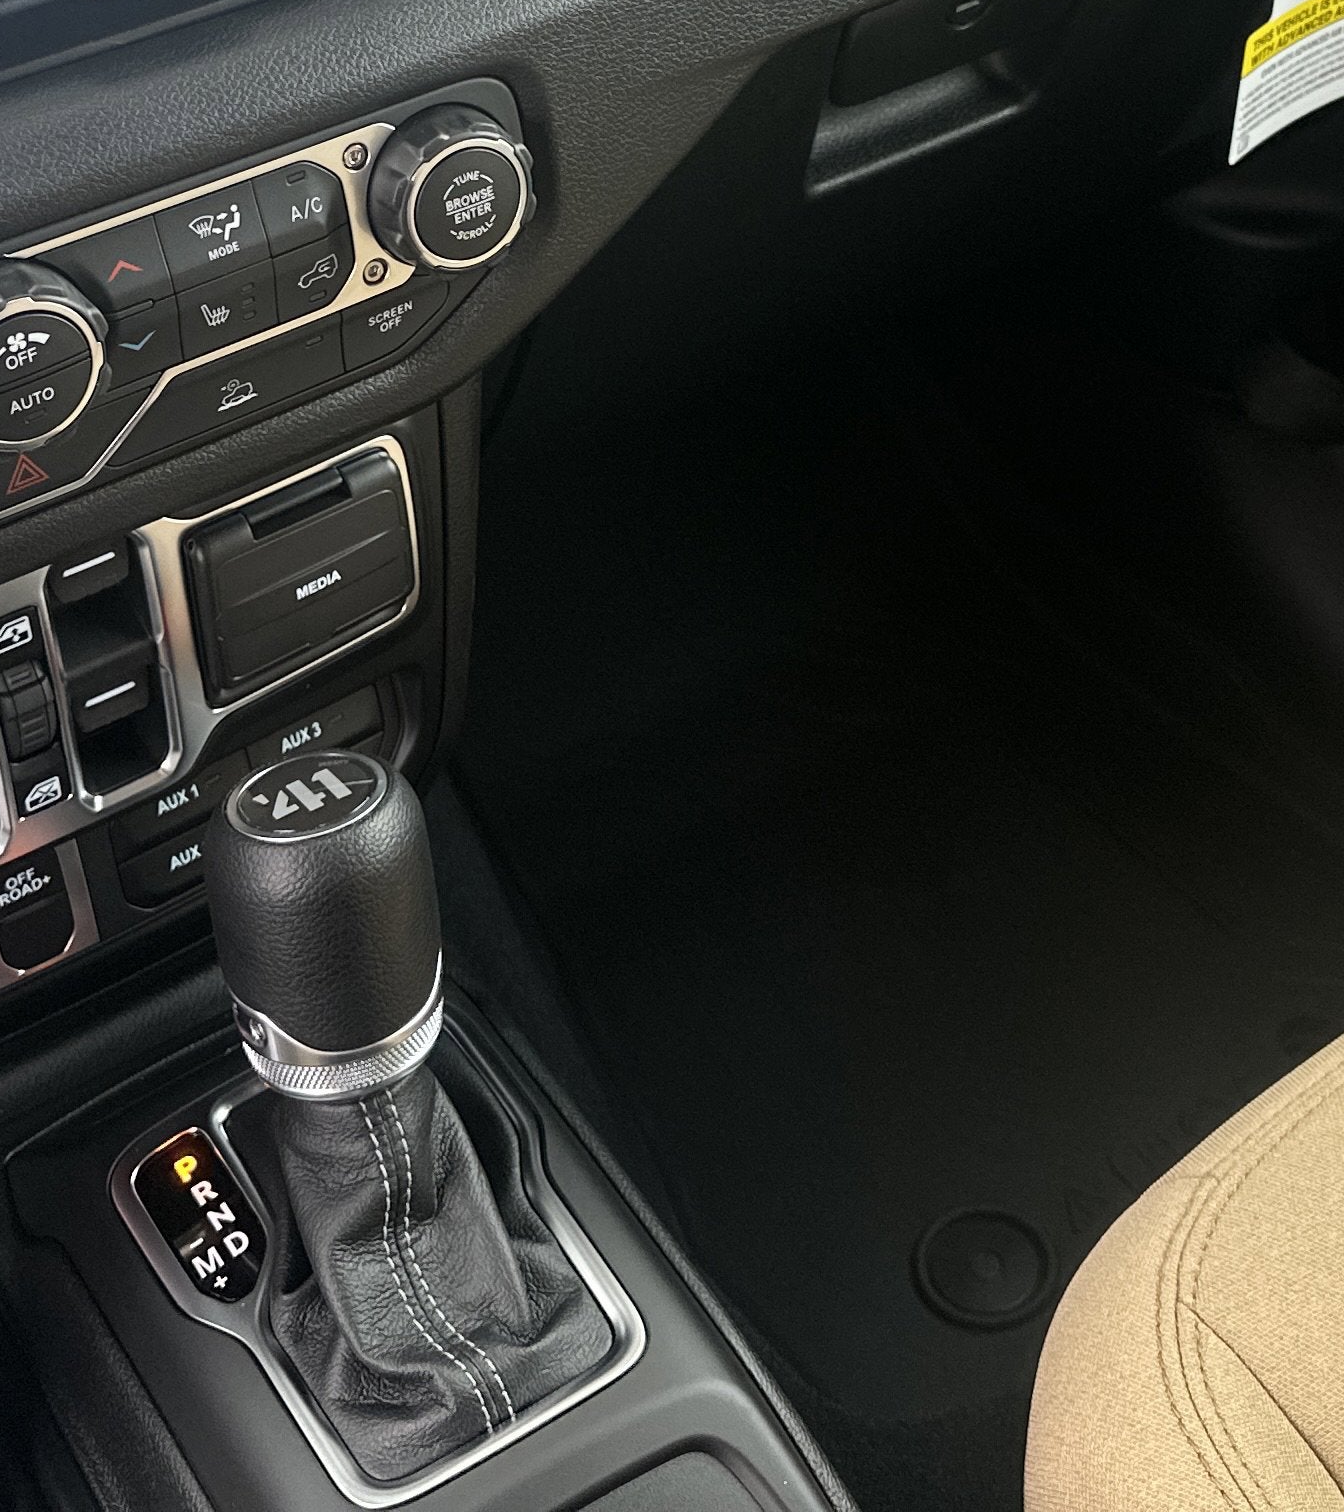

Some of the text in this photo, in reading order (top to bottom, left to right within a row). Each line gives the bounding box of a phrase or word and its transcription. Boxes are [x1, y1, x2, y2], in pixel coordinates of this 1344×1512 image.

[1276, 3, 1319, 36] VEHICLE
[1276, 10, 1334, 48] ADVANCED
[452, 170, 480, 187] TUNE
[289, 196, 324, 223] A/C
[445, 185, 495, 212] BROWSE
[453, 202, 493, 225] ENTER
[456, 221, 494, 241] SCROLL
[208, 241, 241, 262] MODE
[367, 300, 414, 329] SCREEN
[379, 314, 404, 333] OFF
[4, 346, 39, 370] OFF
[9, 386, 56, 416] AUTO
[295, 569, 342, 601] MEDIA
[281, 721, 323, 754] AUX 3
[157, 783, 200, 817] AUX 1
[170, 844, 202, 872] AUX
[5, 867, 36, 891] OFF
[173, 1155, 250, 1258] P R N D
[191, 1245, 225, 1280] M
